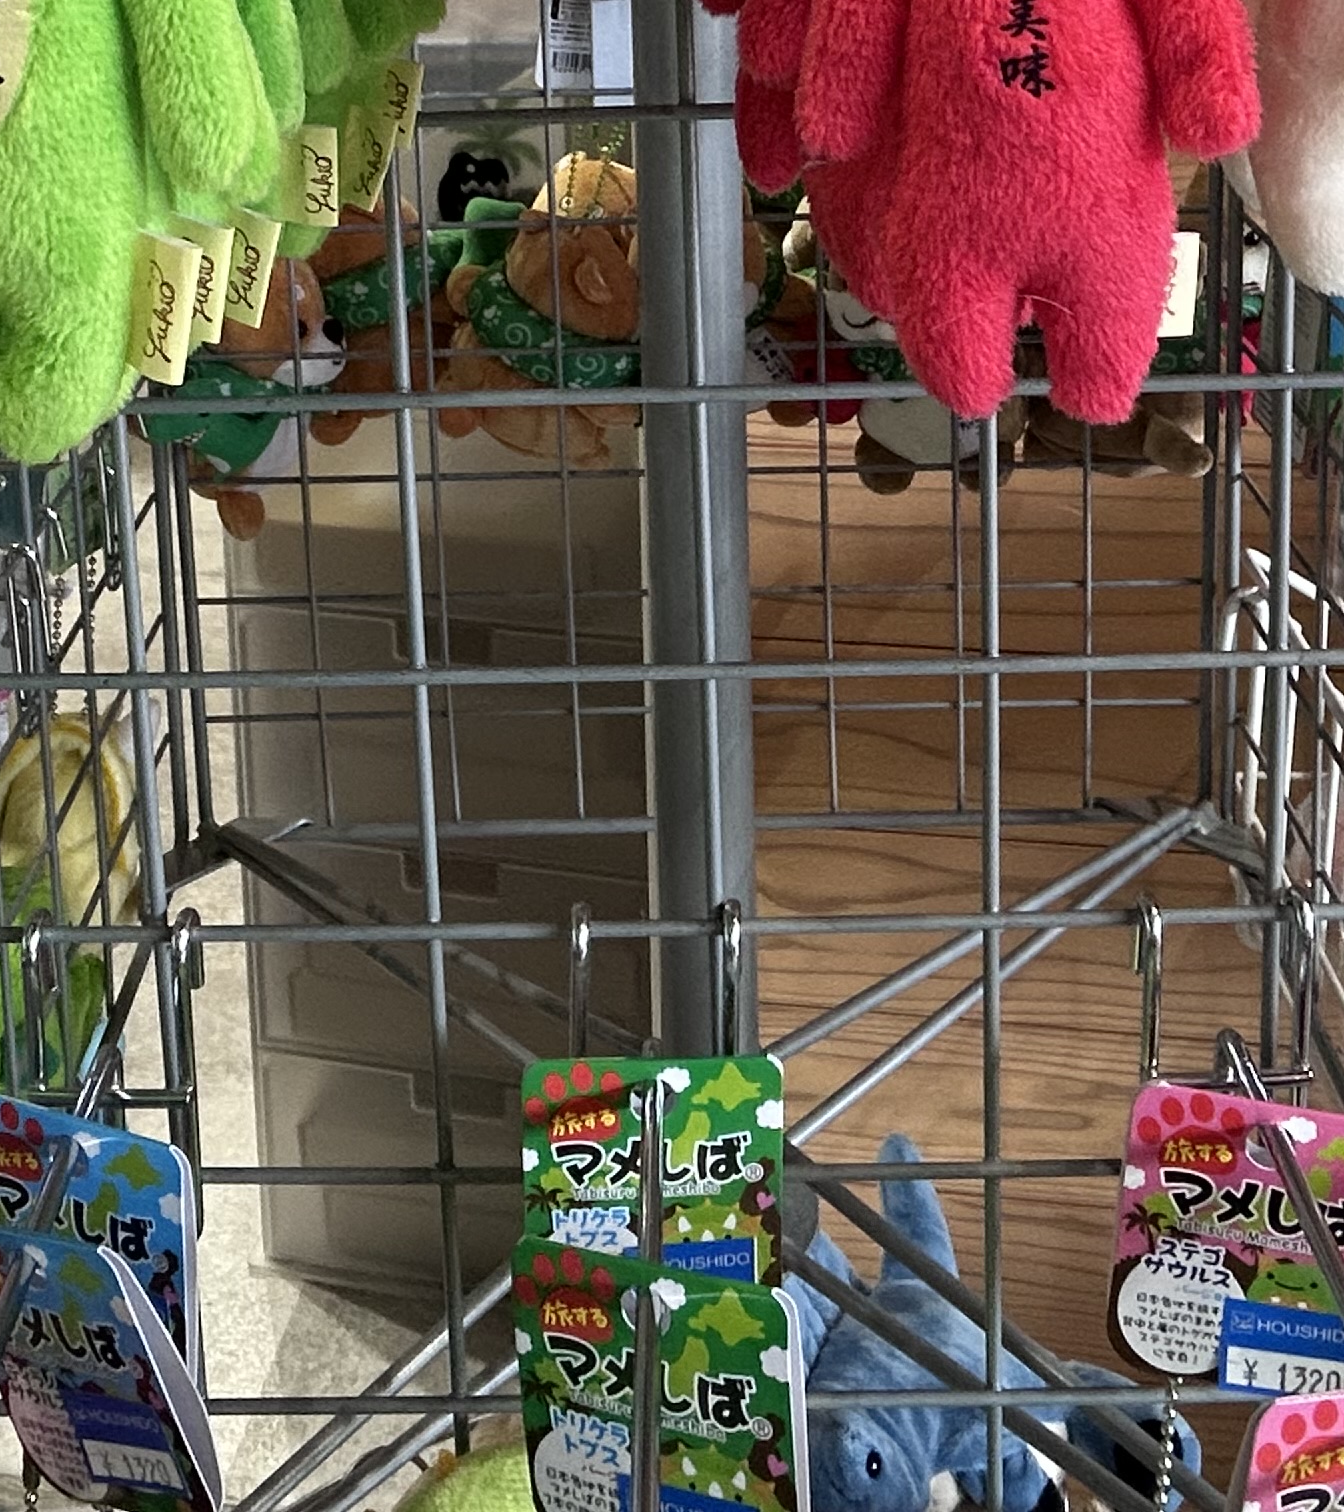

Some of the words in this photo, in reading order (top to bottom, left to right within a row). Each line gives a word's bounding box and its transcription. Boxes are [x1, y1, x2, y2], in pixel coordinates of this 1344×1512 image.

[552, 1108, 616, 1137] 旅する
[1162, 1138, 1234, 1164] 旅する
[1176, 1217, 1246, 1242] Tabisuru
[663, 1250, 751, 1272] OUSHIDO
[1158, 1238, 1221, 1266] ステゴ
[1144, 1256, 1231, 1289] サウルス
[543, 1302, 608, 1328] 旅する
[1242, 1357, 1260, 1387] ¥
[1277, 1362, 1342, 1395] 1320
